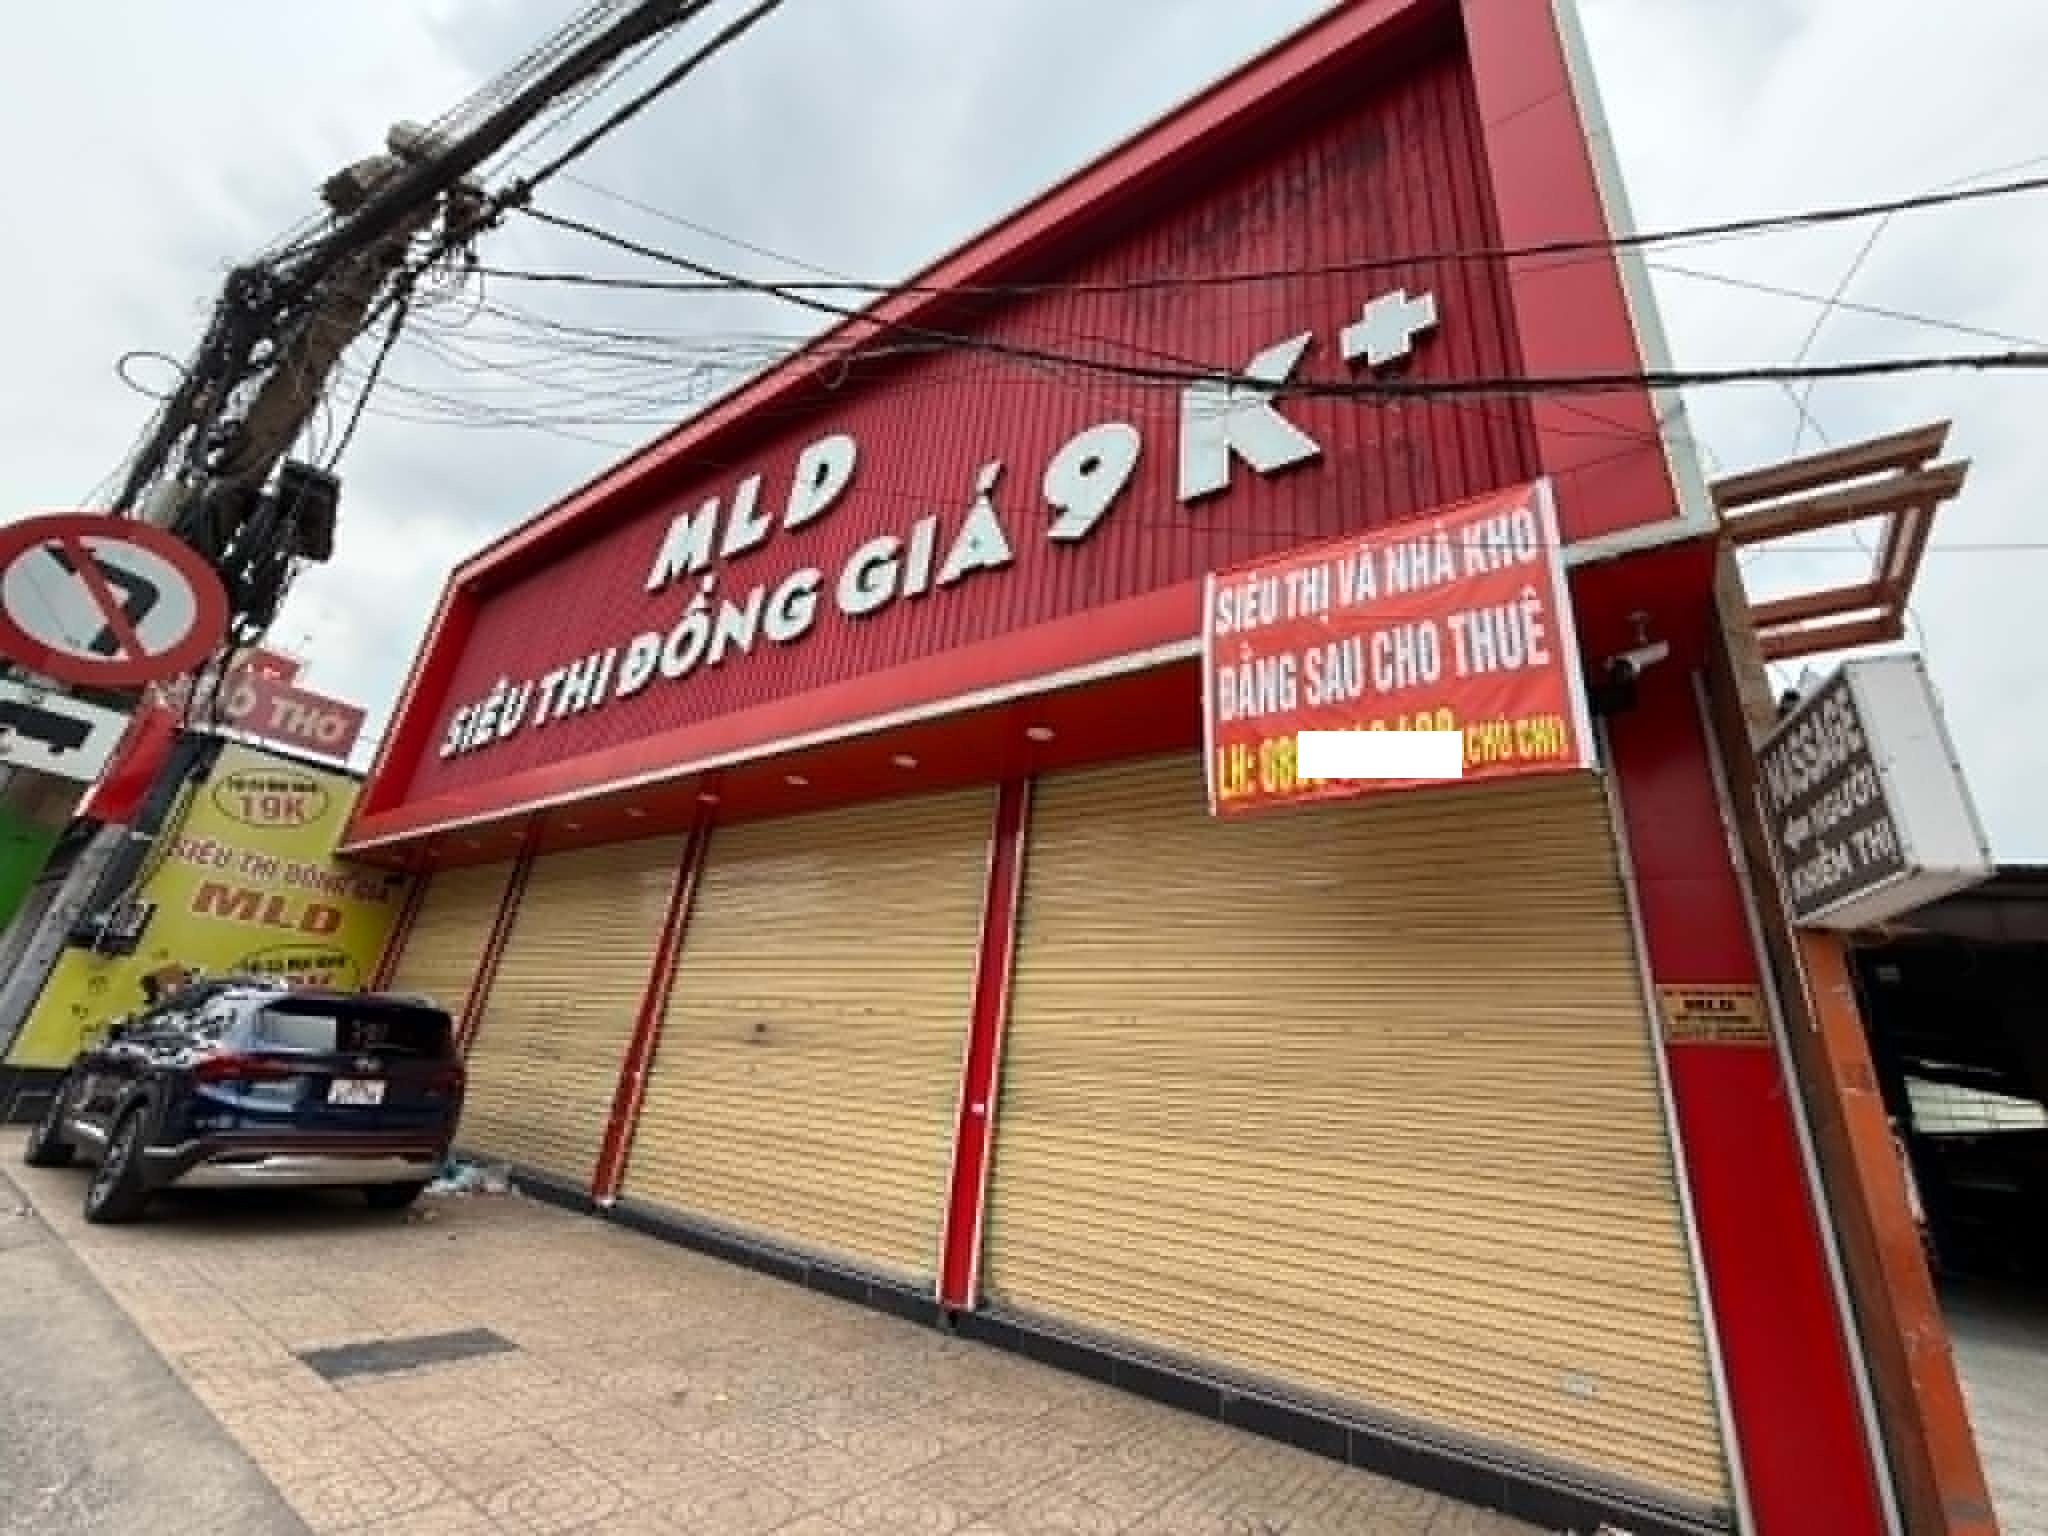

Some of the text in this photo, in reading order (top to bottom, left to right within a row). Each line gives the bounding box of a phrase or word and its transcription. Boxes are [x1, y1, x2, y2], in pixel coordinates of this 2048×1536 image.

[646, 433, 858, 591] MLD
[1283, 564, 1329, 623] THỊ
[1460, 506, 1538, 576] KHO
[615, 566, 823, 697] ĐỒNG
[836, 458, 1015, 616] GIÁ
[1303, 636, 1365, 706] SAU
[1370, 620, 1441, 692] CHO
[1446, 584, 1552, 677] THUÊ
[191, 881, 344, 936] MLD
